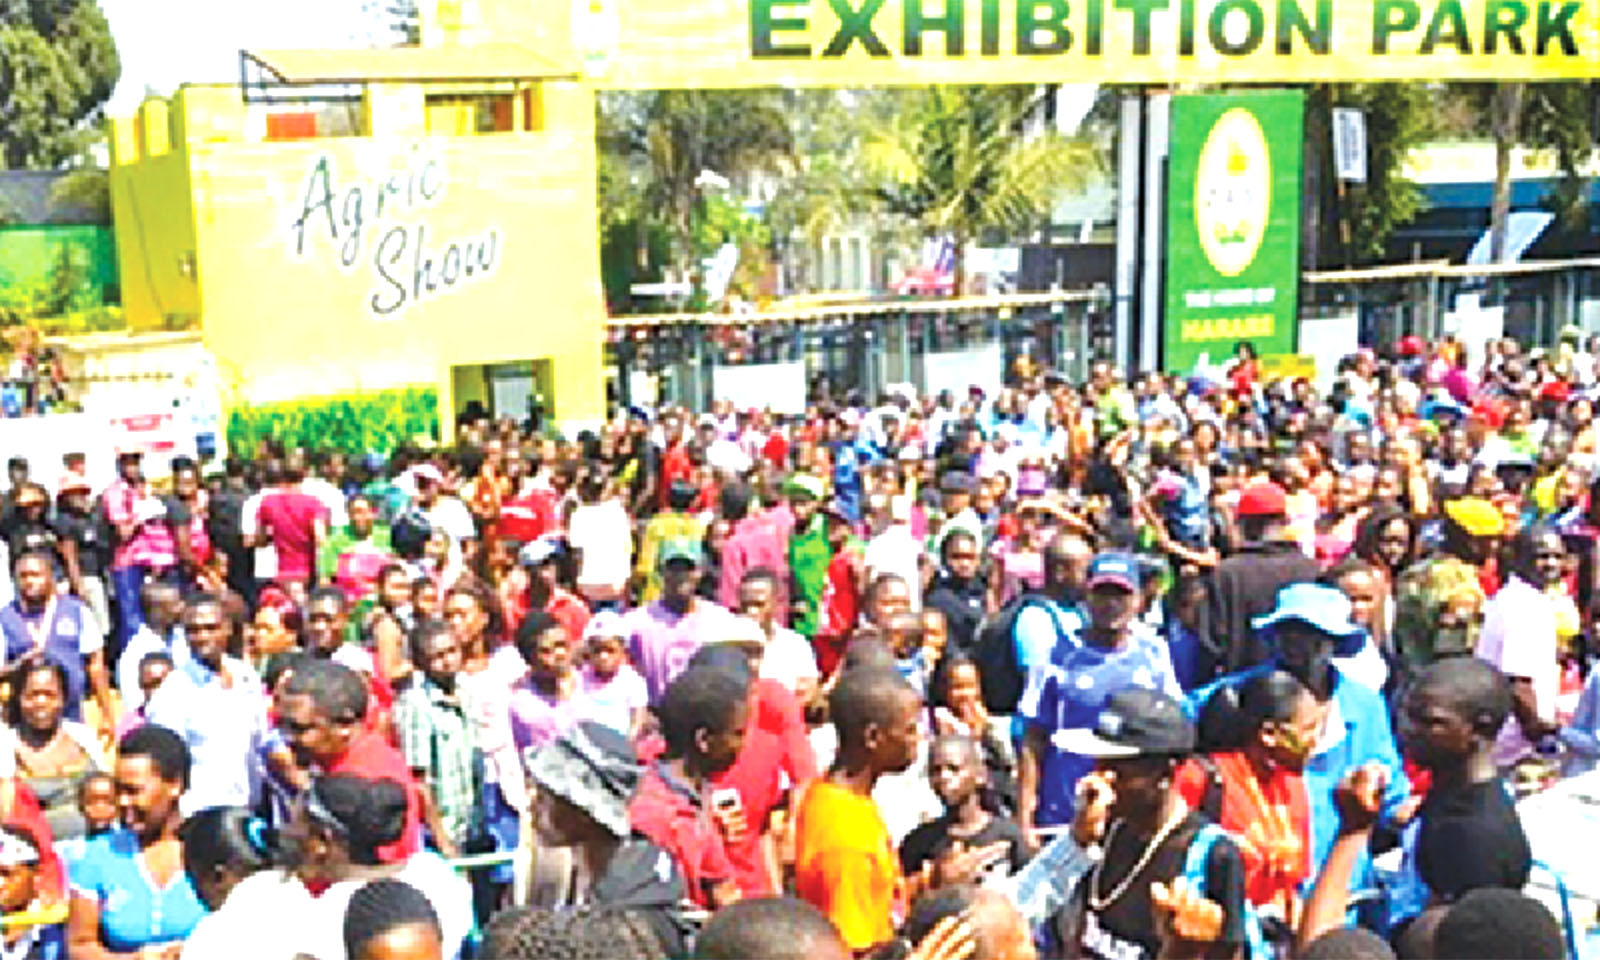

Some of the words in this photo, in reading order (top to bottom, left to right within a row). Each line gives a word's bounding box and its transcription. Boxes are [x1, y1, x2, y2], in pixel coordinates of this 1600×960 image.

[751, 0, 1332, 56] EXHIBITION
[1371, 0, 1580, 56] PARK
[291, 143, 442, 266] Agric
[371, 225, 497, 314] Show
